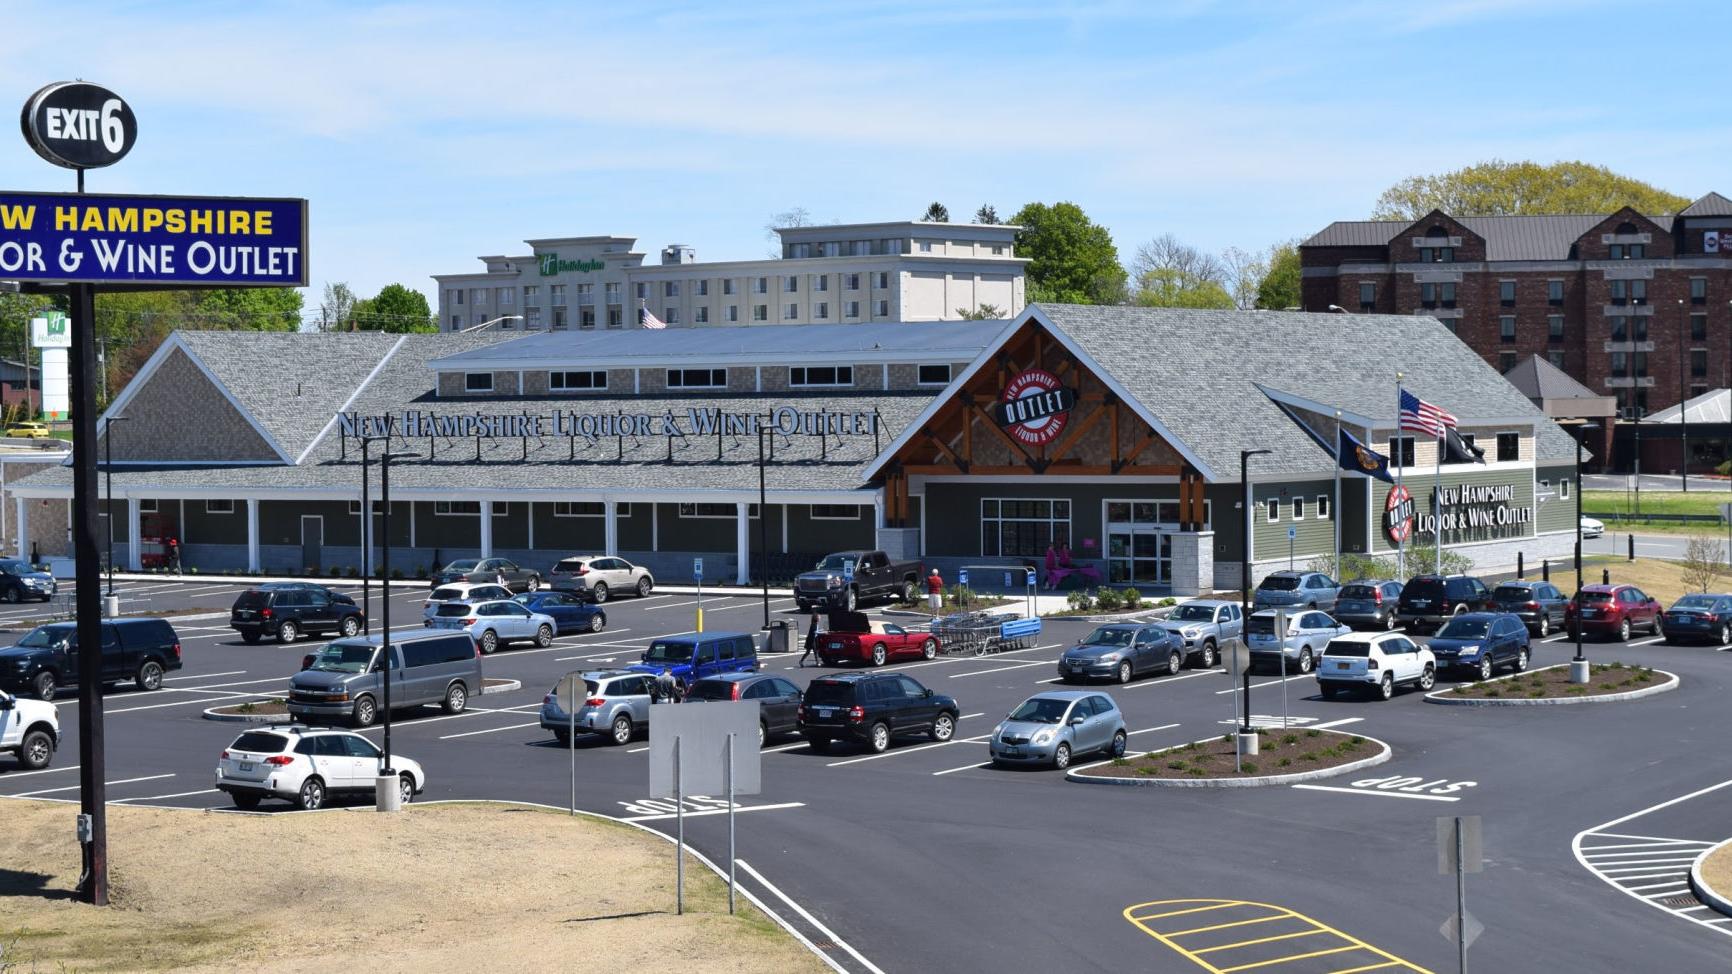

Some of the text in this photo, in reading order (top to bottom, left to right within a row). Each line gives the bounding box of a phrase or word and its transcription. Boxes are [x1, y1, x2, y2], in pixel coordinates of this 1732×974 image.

[46, 99, 124, 154] EXIT 6
[55, 206, 273, 235] HAMPSHIRE
[59, 238, 83, 273] &
[90, 239, 175, 274] WINE
[187, 240, 298, 276] OUTLET
[1006, 390, 1063, 423] OUTLET
[661, 413, 684, 436] &
[1418, 512, 1456, 535] LIQOR
[1459, 513, 1467, 529] &
[1351, 775, 1477, 794] STOP
[617, 795, 742, 814] STOP
